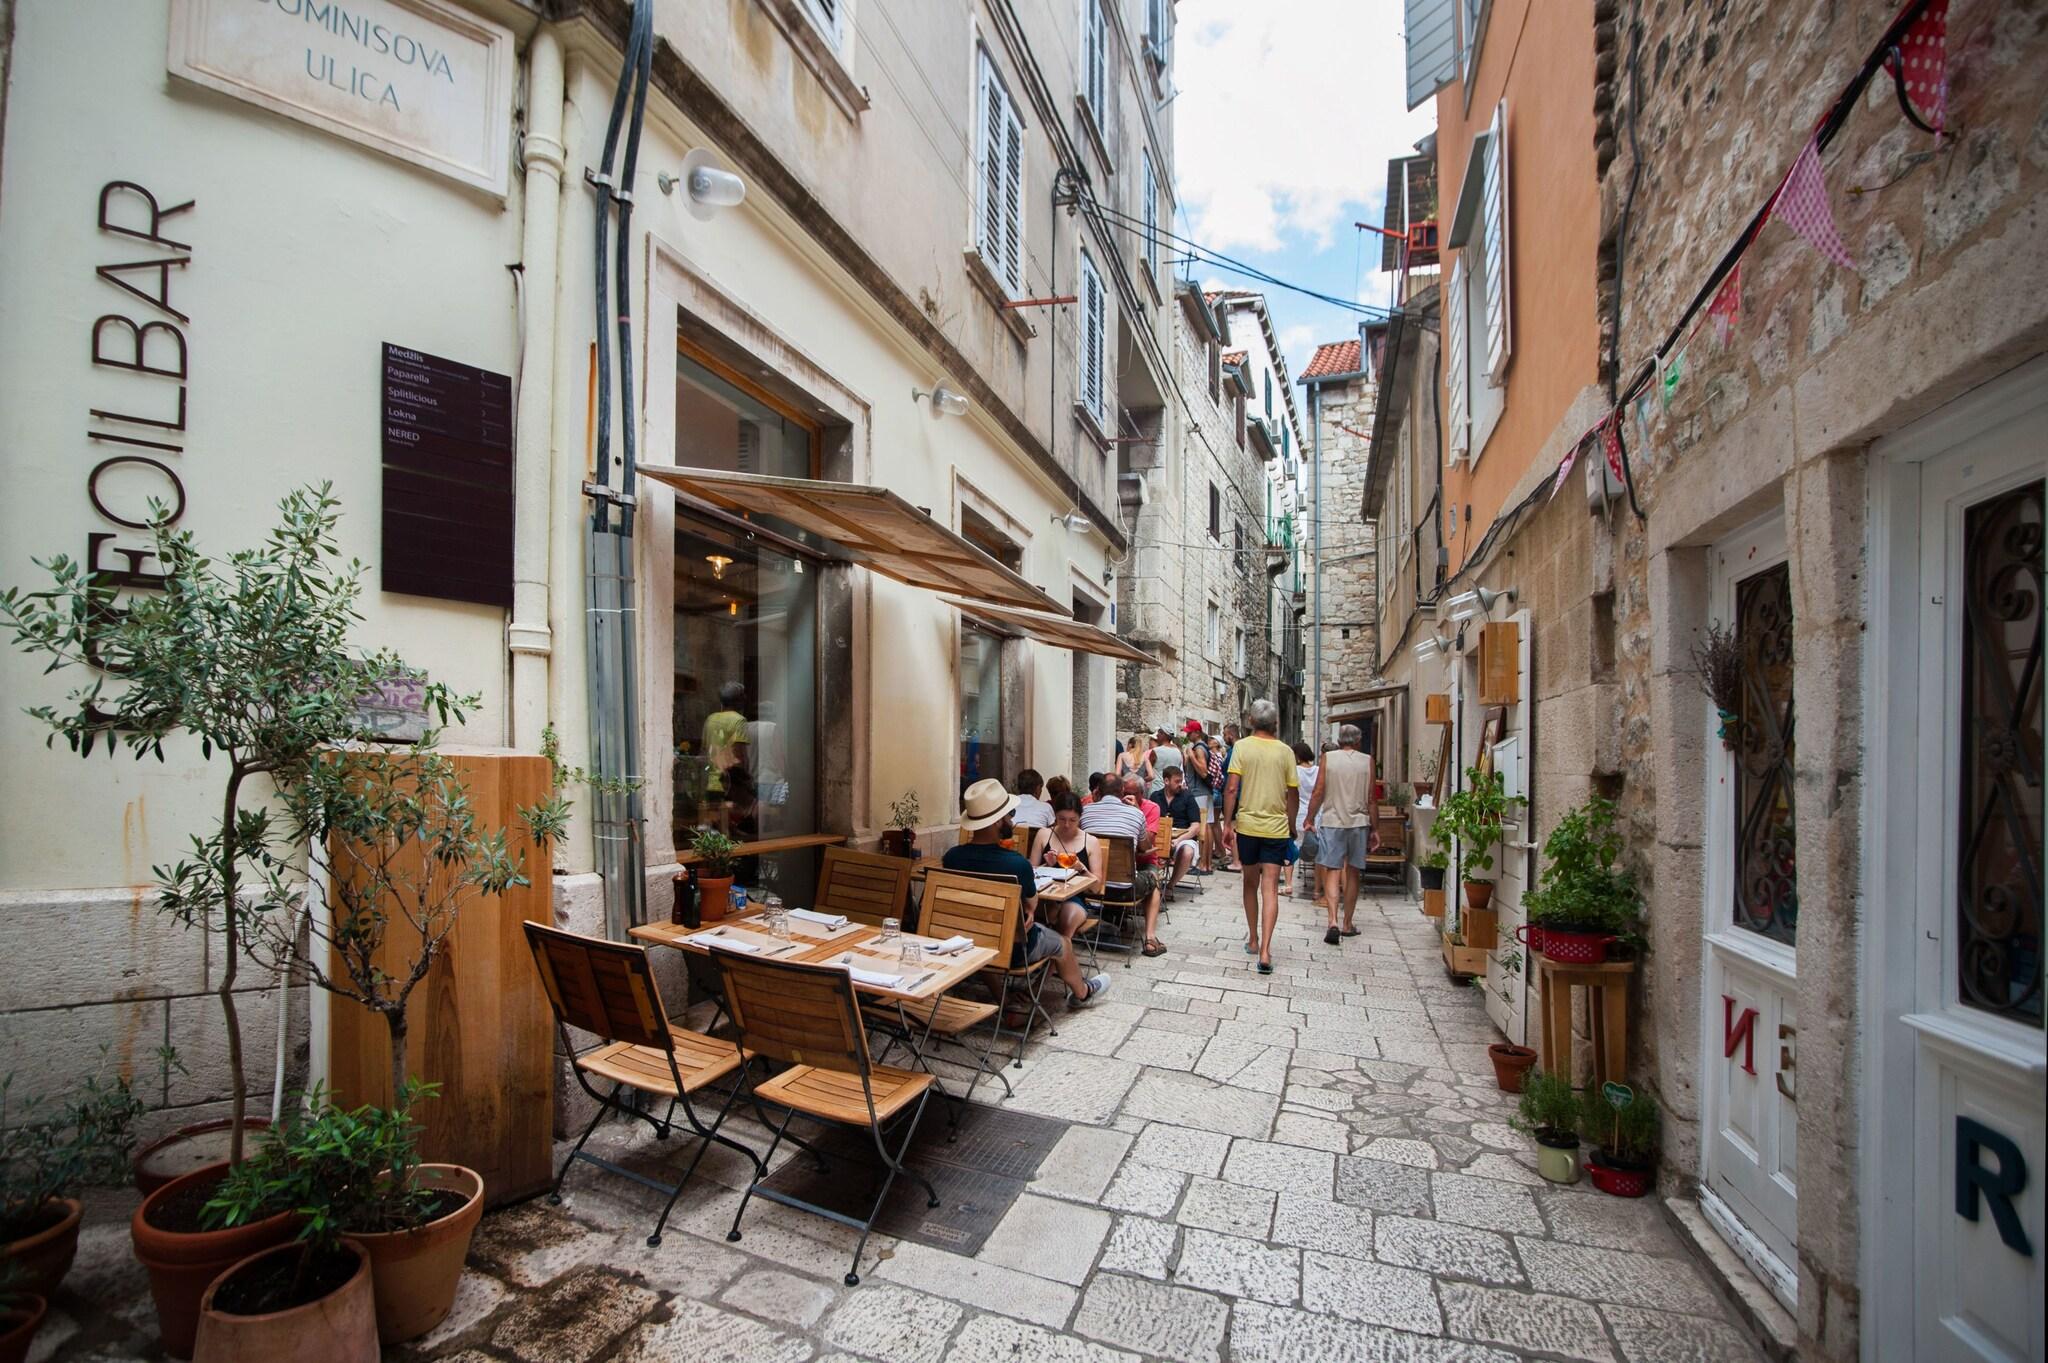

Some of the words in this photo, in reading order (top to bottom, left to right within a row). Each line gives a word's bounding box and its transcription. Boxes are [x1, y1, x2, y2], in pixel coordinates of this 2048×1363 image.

[306, 48, 401, 112] ULICA
[387, 366, 430, 384] Paparella
[388, 386, 438, 406] Splitlicious
[388, 407, 417, 421] Lokna
[388, 427, 420, 441] NERED
[1955, 1115, 2033, 1258] R
